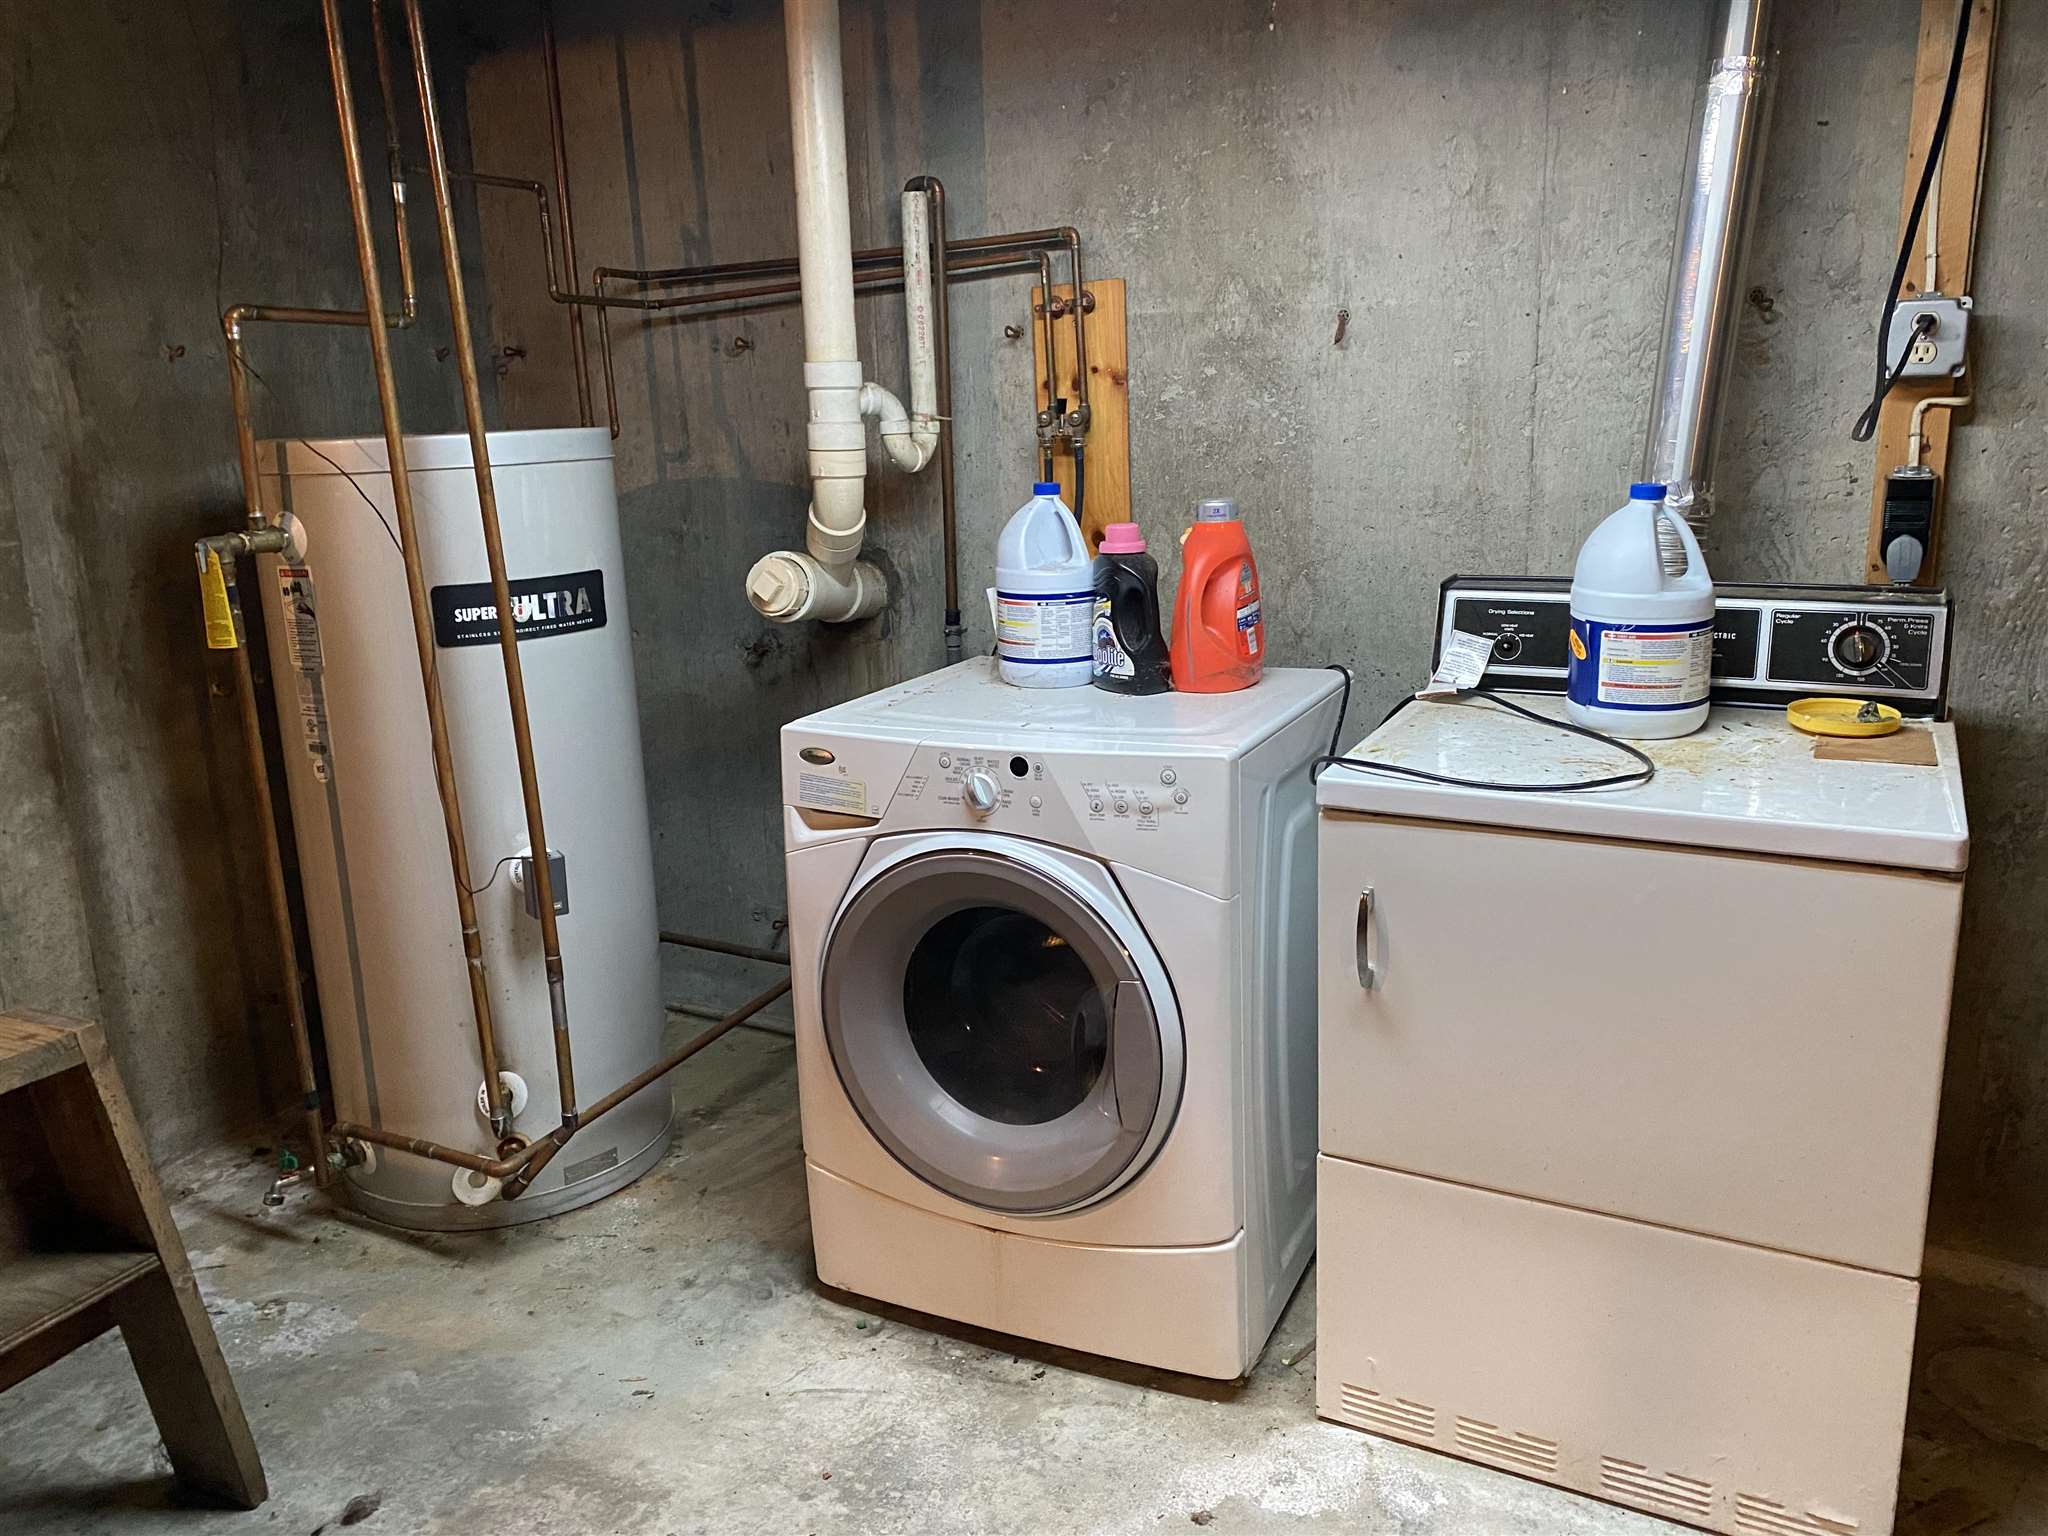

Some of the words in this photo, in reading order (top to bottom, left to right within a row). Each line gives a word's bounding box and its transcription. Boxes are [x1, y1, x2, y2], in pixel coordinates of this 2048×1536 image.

[454, 606, 498, 623] SUPER
[512, 587, 592, 623] ULTRA
[1488, 608, 1506, 616] Drying
[515, 625, 540, 634] NDIRECT
[1713, 632, 1737, 640] CTRIC
[1096, 646, 1125, 668] oolite
